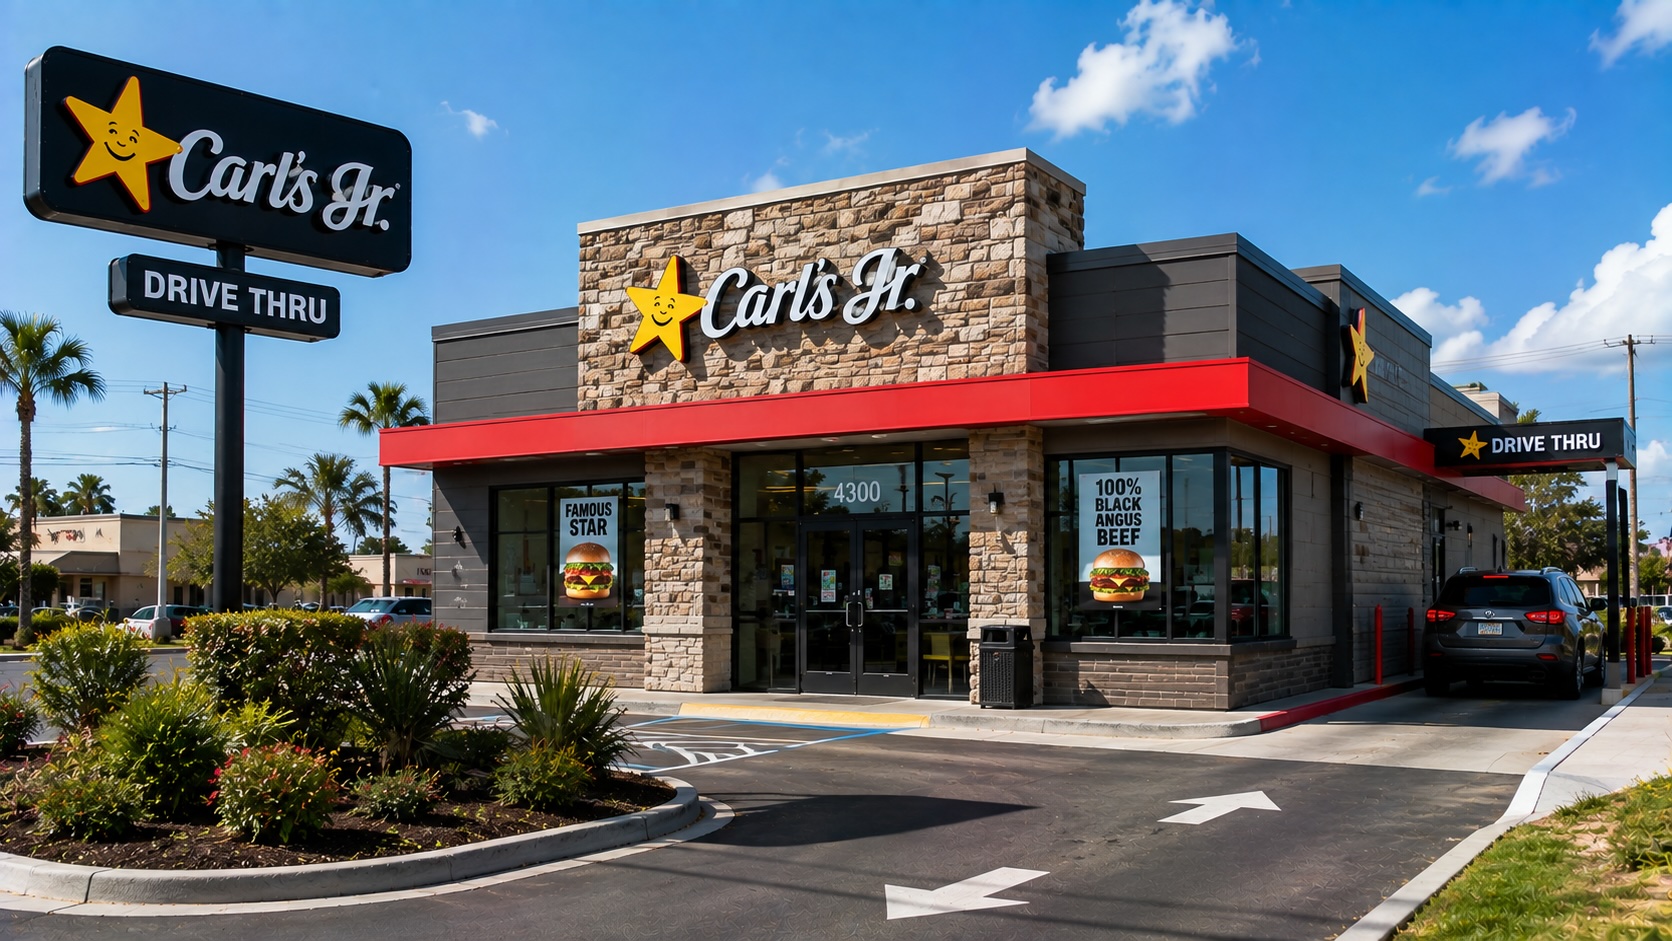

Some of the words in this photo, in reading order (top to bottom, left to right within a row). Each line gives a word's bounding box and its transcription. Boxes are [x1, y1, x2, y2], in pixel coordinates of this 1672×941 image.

[169, 129, 318, 214] Carl's
[321, 162, 395, 232] Jr.
[143, 269, 239, 312] DRIVE
[248, 287, 327, 325] THRU
[700, 257, 837, 339] Carl's
[842, 247, 921, 326] Jr.
[1491, 435, 1546, 455] DRIVE
[1550, 432, 1602, 451] THRU
[833, 480, 881, 504] 4300
[1095, 477, 1142, 496] 100%
[565, 501, 612, 518] FAMOUS
[1095, 496, 1142, 512] BLACK
[569, 518, 608, 536] STAR
[1095, 512, 1142, 527] ANGUS
[1096, 528, 1141, 546] BEEF
